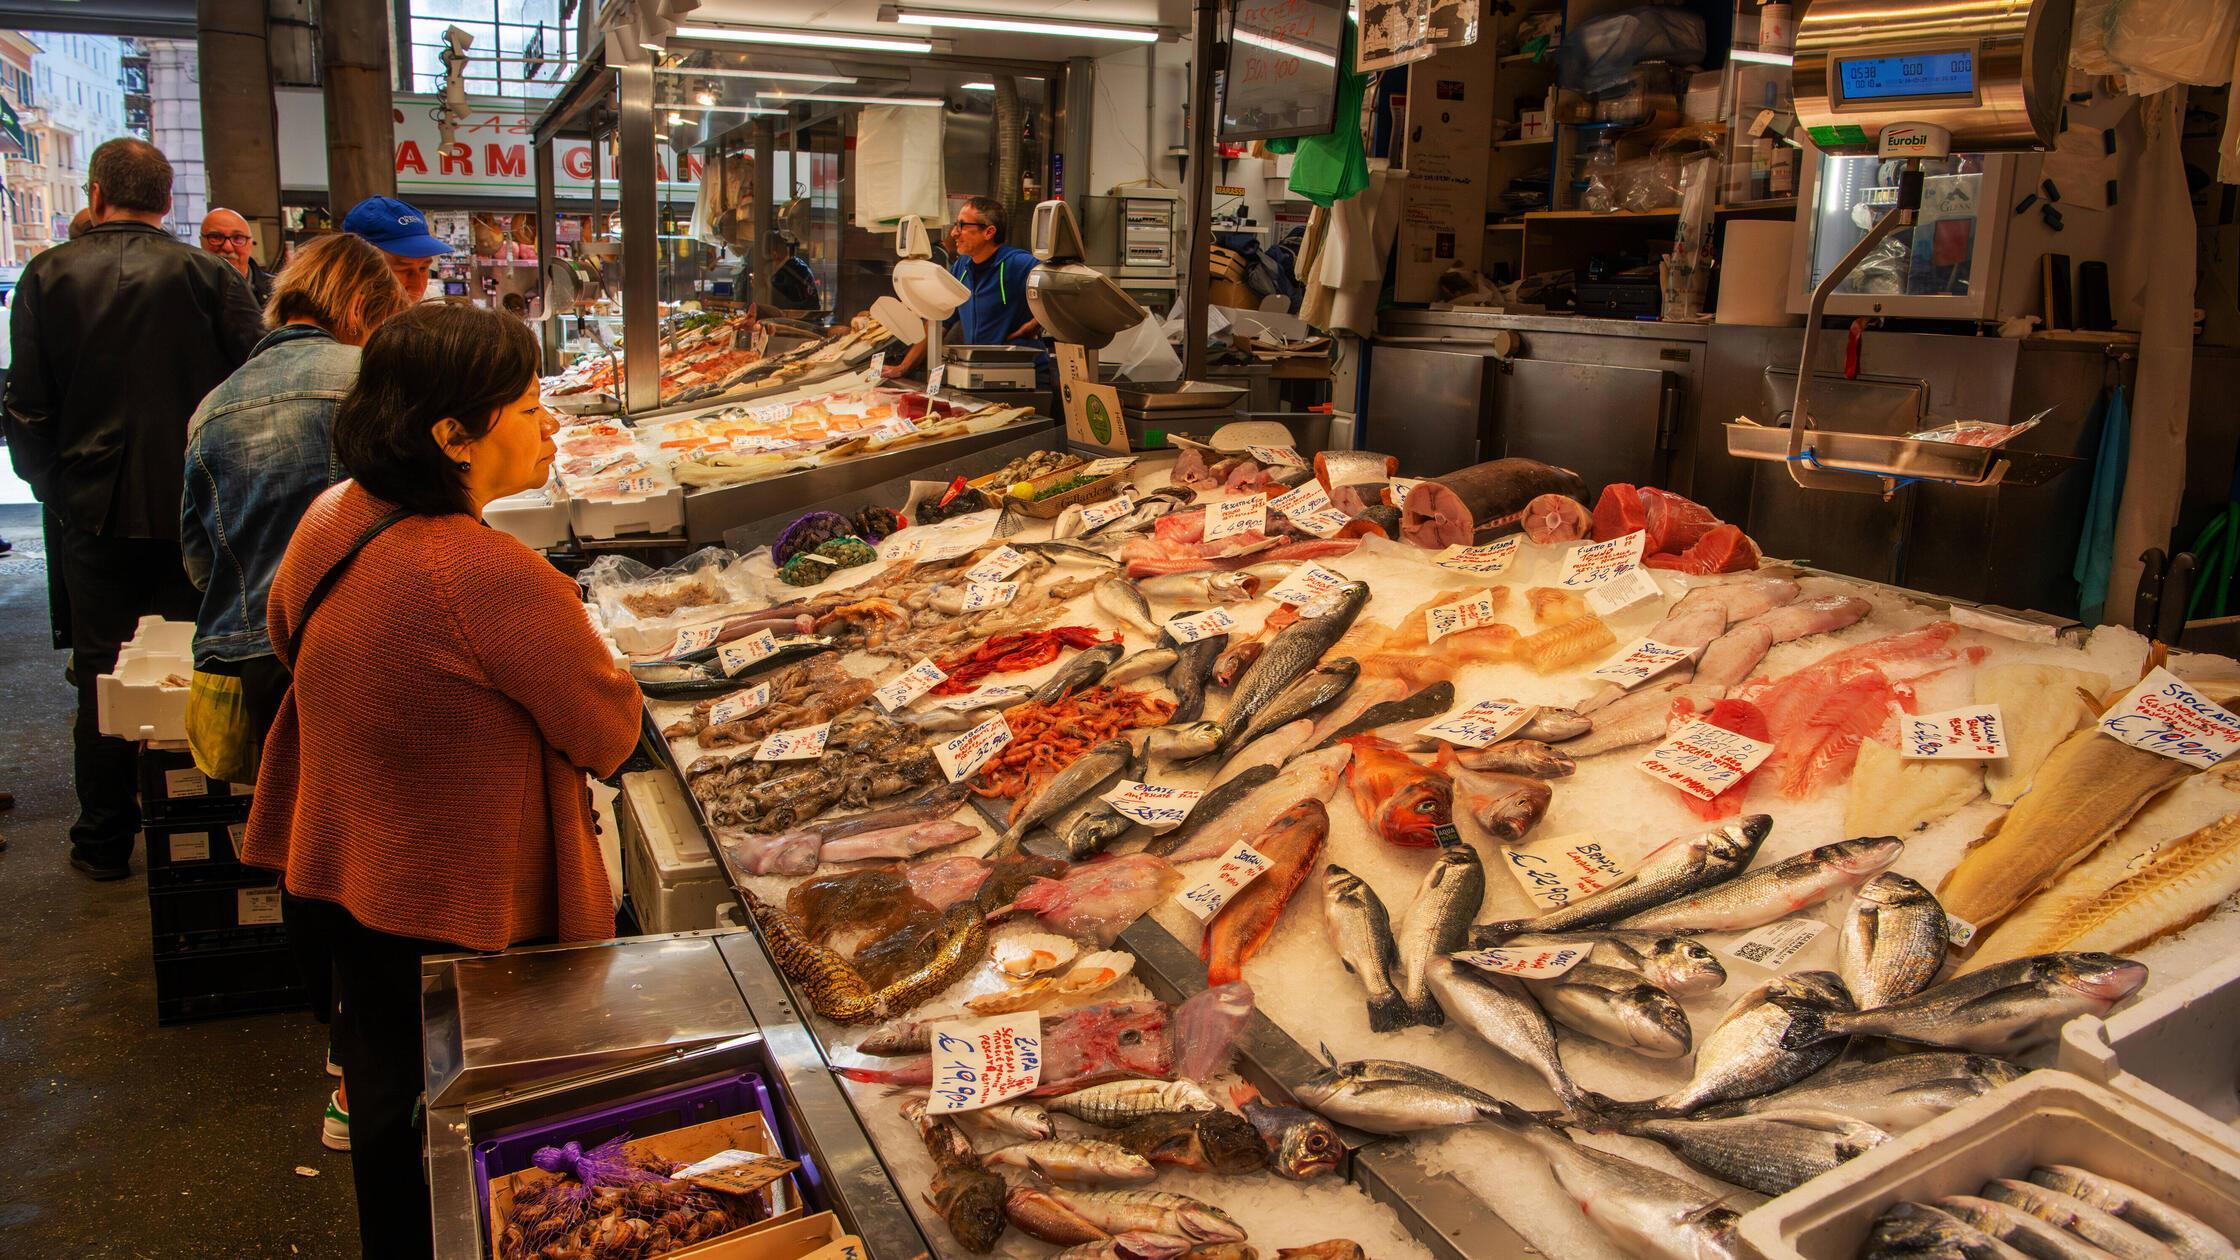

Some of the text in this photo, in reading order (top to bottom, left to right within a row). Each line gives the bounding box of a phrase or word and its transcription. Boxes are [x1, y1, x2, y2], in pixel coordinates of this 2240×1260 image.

[1887, 135, 1927, 146] Eurobil
[1563, 572, 1580, 585] €
[1914, 721, 1939, 731] €
[2104, 714, 2152, 733] €
[1686, 722, 1741, 744] FILETTI
[1654, 749, 1679, 759] €
[1670, 741, 1713, 759] PESCATO
[1682, 734, 1749, 760] PERSICO
[955, 761, 974, 778] €
[1642, 760, 1671, 773] RETI
[1133, 784, 1177, 794] ORATE
[1110, 800, 1130, 811] €
[1508, 851, 1549, 868] €
[938, 1032, 975, 1053] €
[1013, 1036, 1040, 1072] ZUPPA
